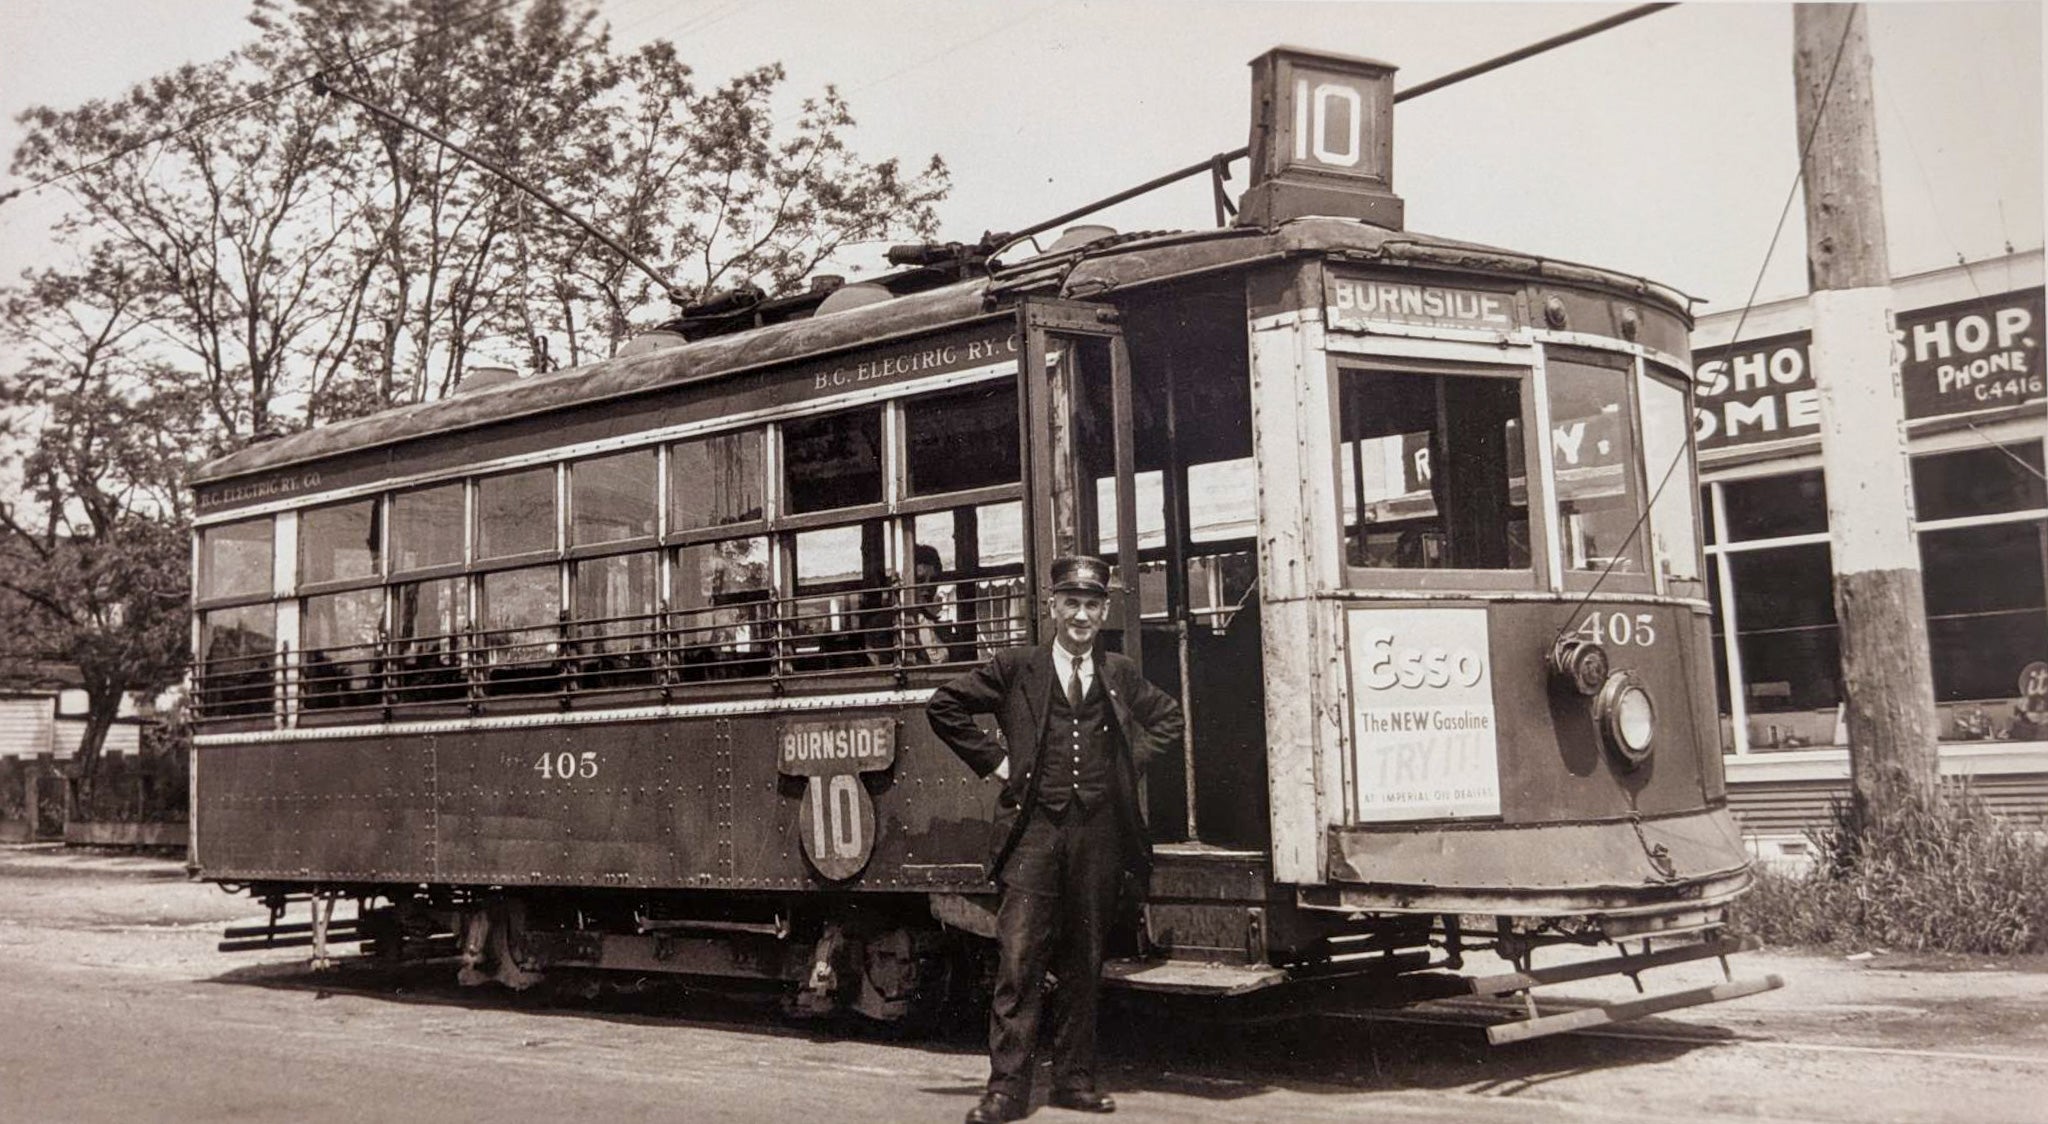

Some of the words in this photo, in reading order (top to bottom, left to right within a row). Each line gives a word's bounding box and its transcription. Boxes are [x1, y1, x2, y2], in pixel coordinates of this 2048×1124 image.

[1296, 79, 1361, 167] 10
[1336, 283, 1508, 323] BURNSIDE
[814, 369, 850, 390] B.C.
[857, 346, 957, 381] ELECTRIC
[968, 337, 1000, 361] RY.
[1695, 347, 1817, 397] SHO
[1938, 351, 2028, 394] PHONE
[1578, 611, 1655, 647] 405
[1362, 626, 1484, 691] Esso
[783, 727, 888, 762] BURNSIDE
[1361, 712, 1388, 733] The
[1391, 711, 1429, 732] NEW
[1433, 710, 1489, 731] Gasoline
[533, 752, 600, 779] 405
[1375, 737, 1437, 788] TRY
[809, 775, 863, 860] 10
